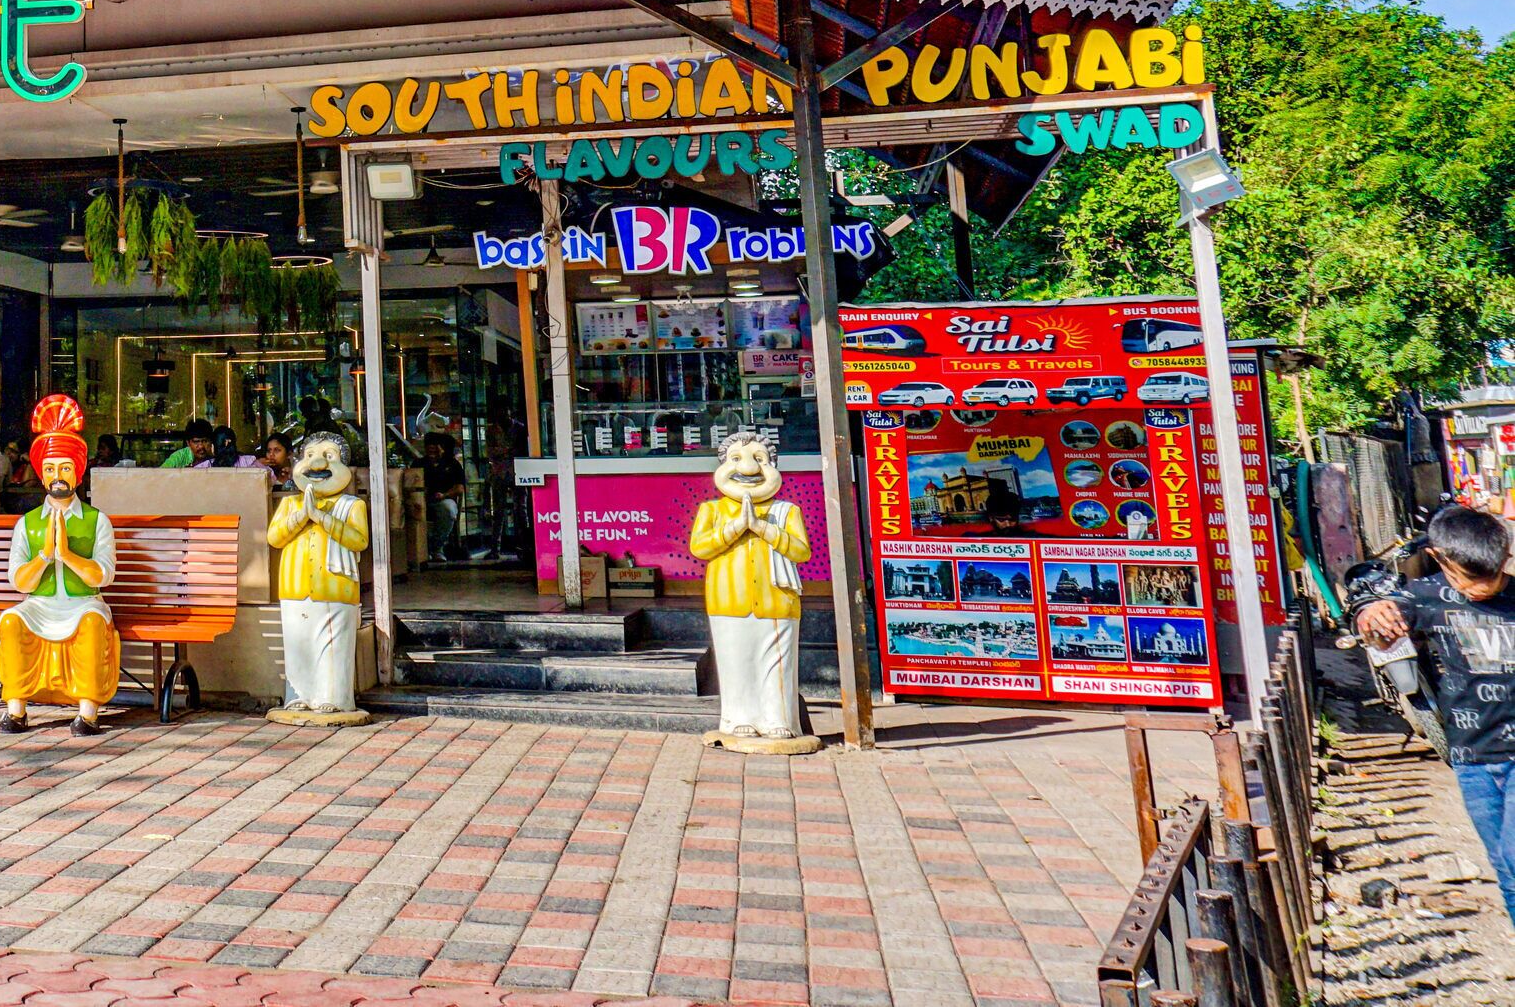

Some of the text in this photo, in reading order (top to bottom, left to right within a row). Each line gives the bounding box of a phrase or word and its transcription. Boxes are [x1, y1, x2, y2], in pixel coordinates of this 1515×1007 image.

[308, 69, 541, 138] SOUTH
[1015, 103, 1205, 156] SWAD
[499, 129, 794, 185] FLAVOURS
[612, 206, 720, 274] BR
[870, 313, 919, 321] ENQUIRY
[1123, 306, 1200, 316] BUS BOOKIN
[946, 315, 1010, 333] Sai
[957, 334, 1055, 352] Tulsi
[772, 353, 799, 362] CAKE
[852, 362, 911, 371] 9561265040
[950, 358, 1094, 370] Tours & Travels
[847, 385, 865, 393] RENT
[866, 410, 882, 418] Sai
[1148, 409, 1165, 417] Sai
[869, 417, 893, 426] Tulsi
[1151, 416, 1178, 425] Tulsi
[976, 439, 1031, 451] MUMBAI
[978, 450, 1016, 458] DARSHAN
[873, 432, 901, 535] TRAVELS
[1155, 431, 1192, 539] TRAVELS
[584, 510, 654, 523] FLAVORS.
[596, 529, 631, 541] FUN.
[883, 543, 953, 554] NASHIK DARSHAN
[1043, 546, 1127, 558] SAMBHAJI NAGAR DARSHAN
[896, 673, 1035, 688] MUMBAI DARSHAN
[1064, 679, 1201, 695] SHANI SHINGNAPUR
